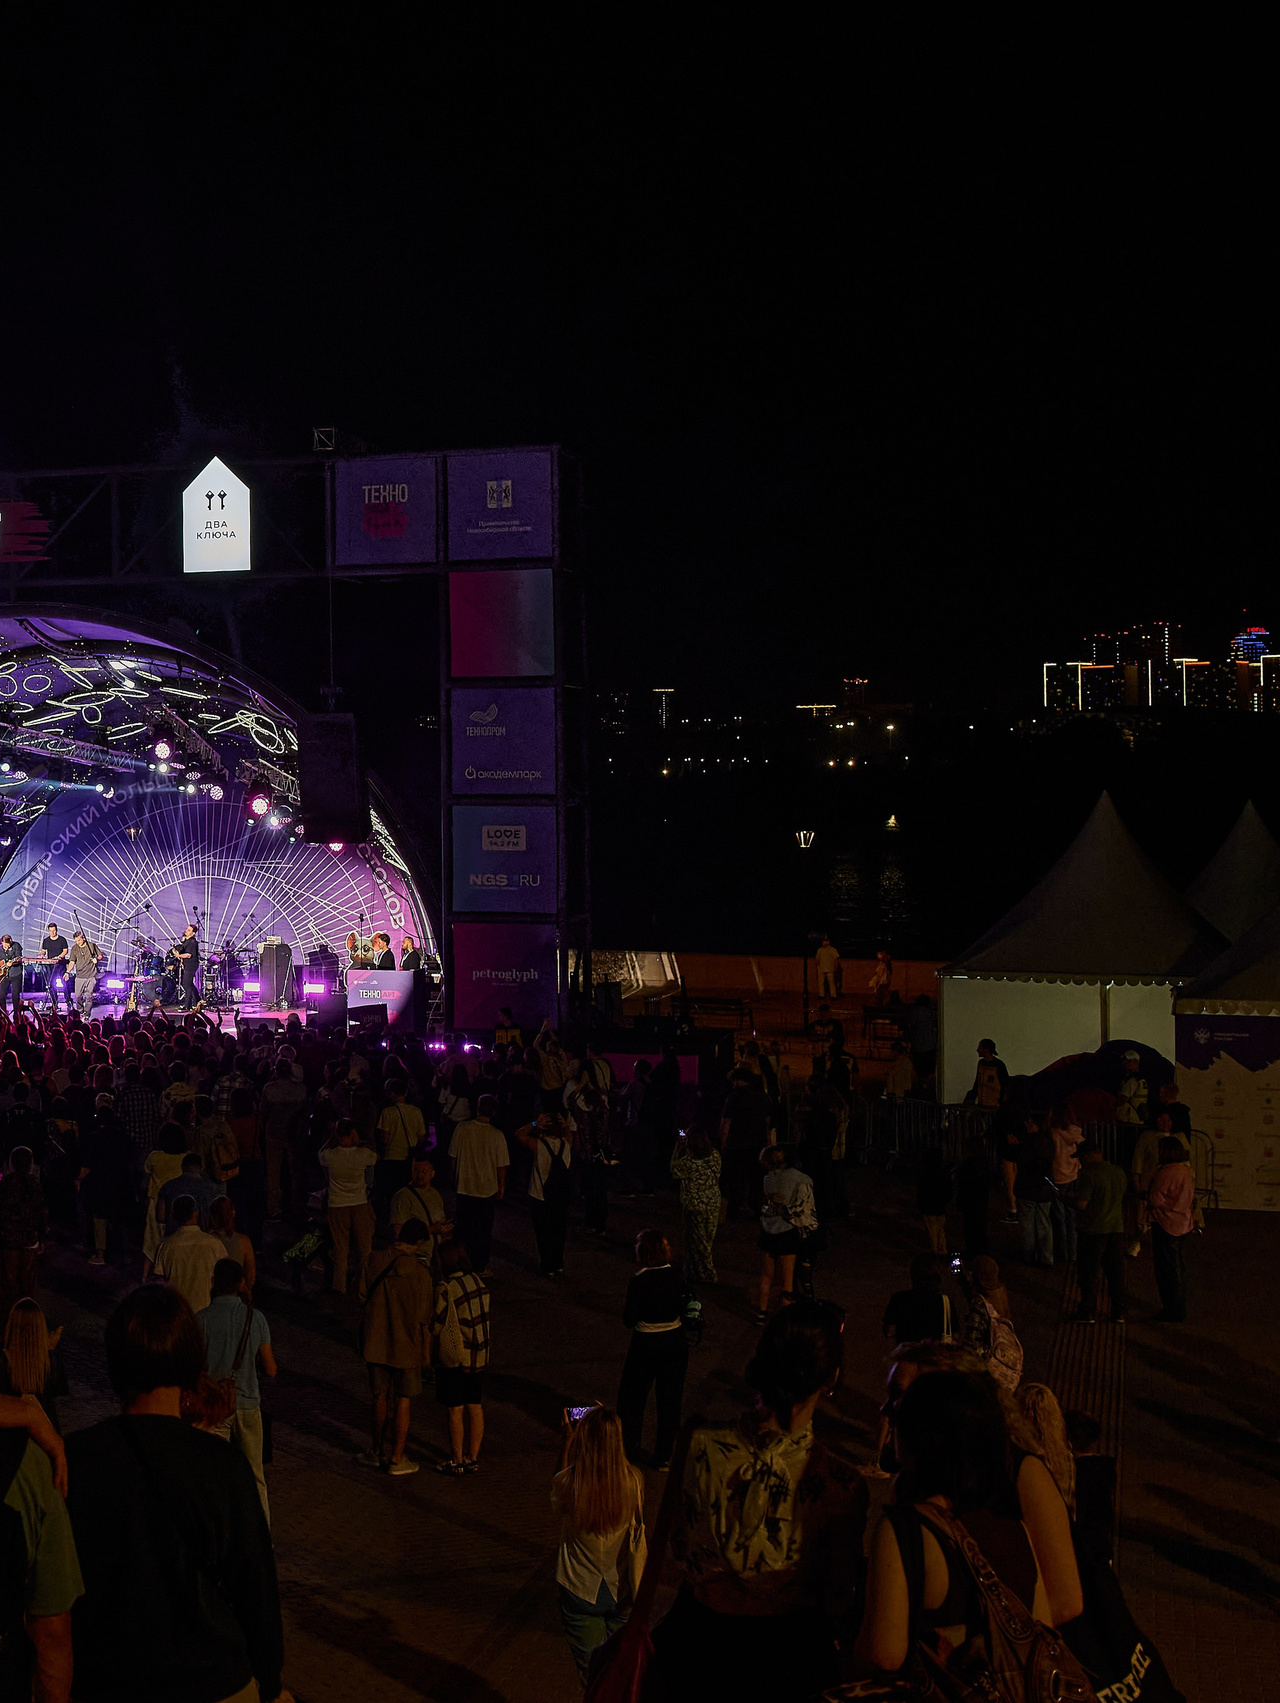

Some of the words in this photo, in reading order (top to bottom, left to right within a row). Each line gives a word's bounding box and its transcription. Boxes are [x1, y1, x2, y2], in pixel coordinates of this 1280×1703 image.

[362, 483, 409, 504] ТЕХНО
[204, 520, 228, 530] ДВА
[196, 531, 237, 540] КЛЮЧА
[11, 804, 100, 921] СИБИРСКИЙ
[472, 968, 539, 982] petroglyph
[359, 989, 381, 999] ТЕХНО
